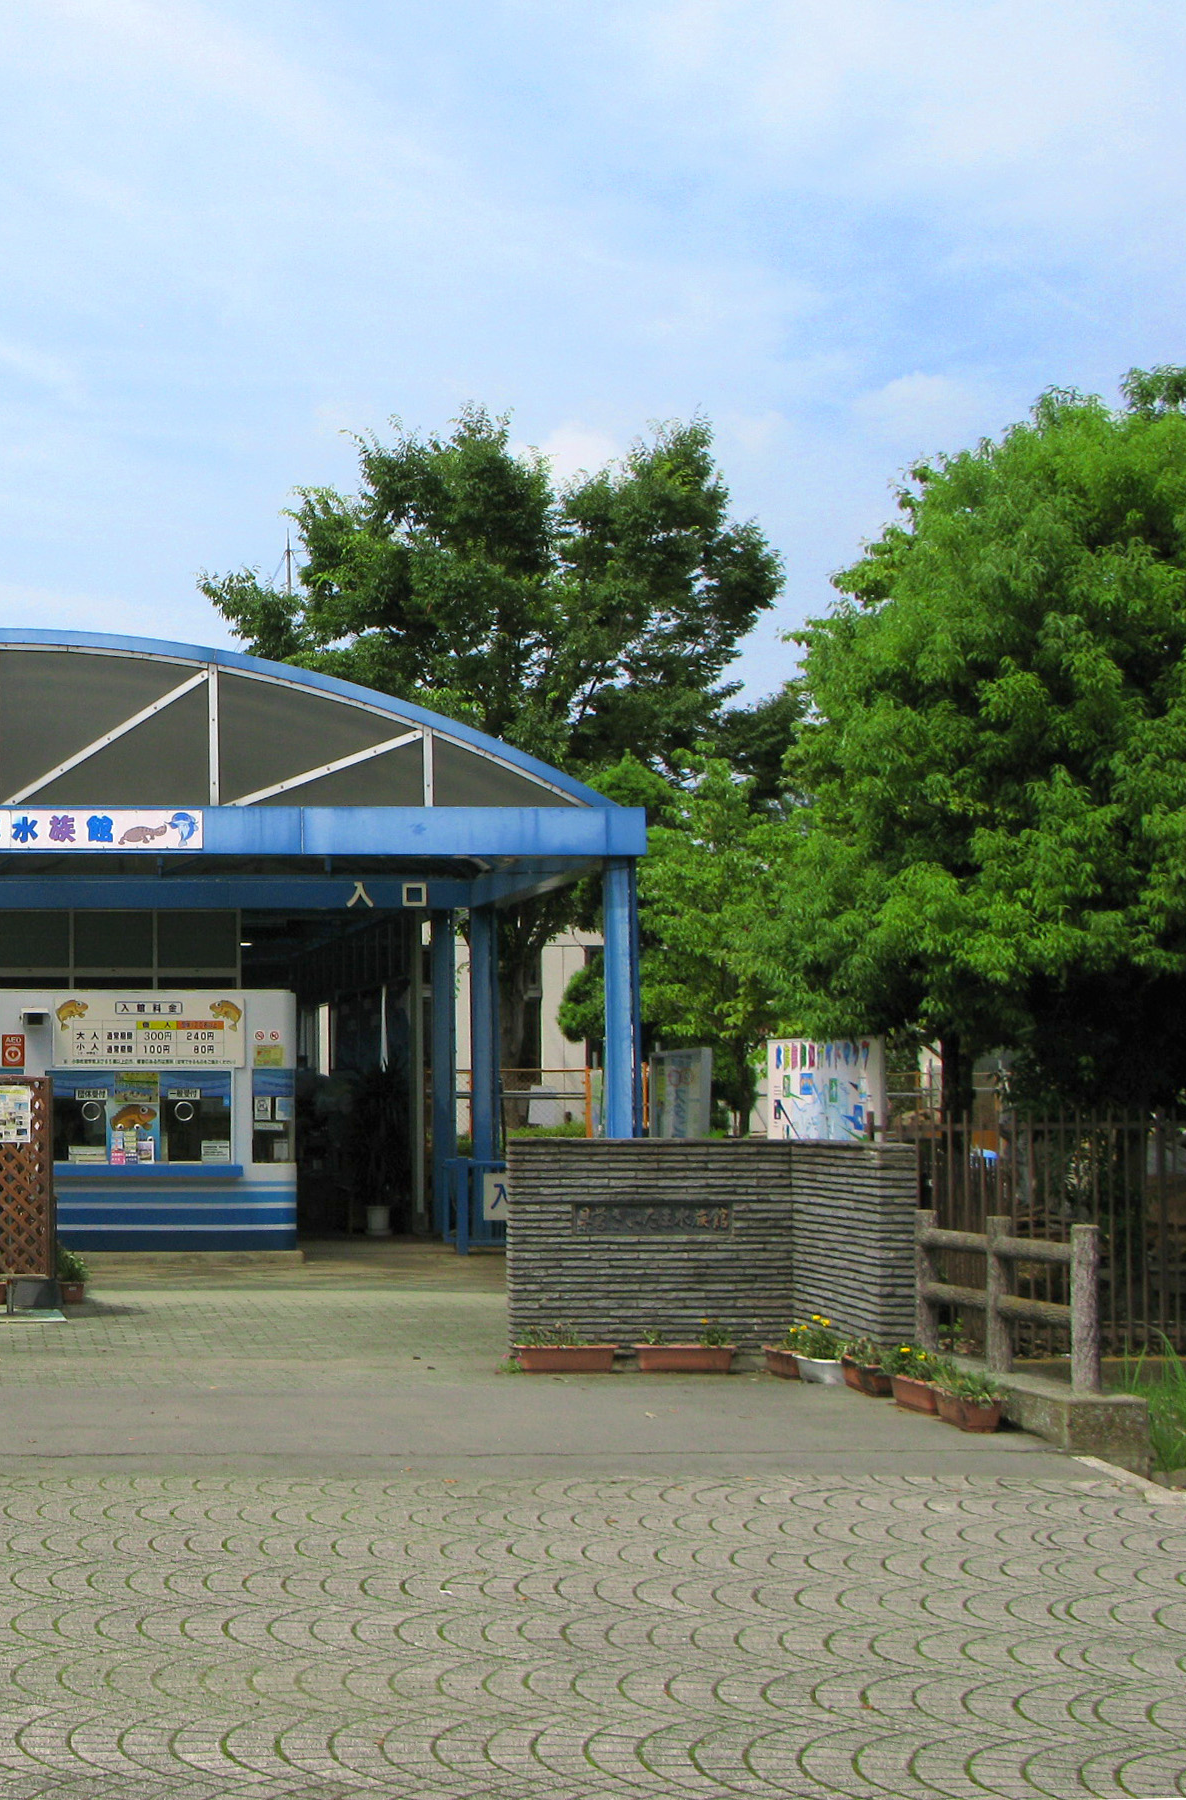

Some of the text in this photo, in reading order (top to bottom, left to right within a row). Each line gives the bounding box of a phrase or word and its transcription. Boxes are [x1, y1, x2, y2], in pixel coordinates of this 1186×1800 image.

[346, 881, 427, 907] 入口
[121, 1003, 178, 1013] 入館料金
[76, 1031, 214, 1041] 大人 通常期間 300円 240円
[76, 1043, 99, 1051] 小人
[106, 1045, 133, 1054] 通常期間
[143, 1045, 170, 1054] 100円
[193, 1045, 214, 1054] 80円
[77, 1090, 106, 1099] 団体受付
[169, 1089, 198, 1098] 一般受付
